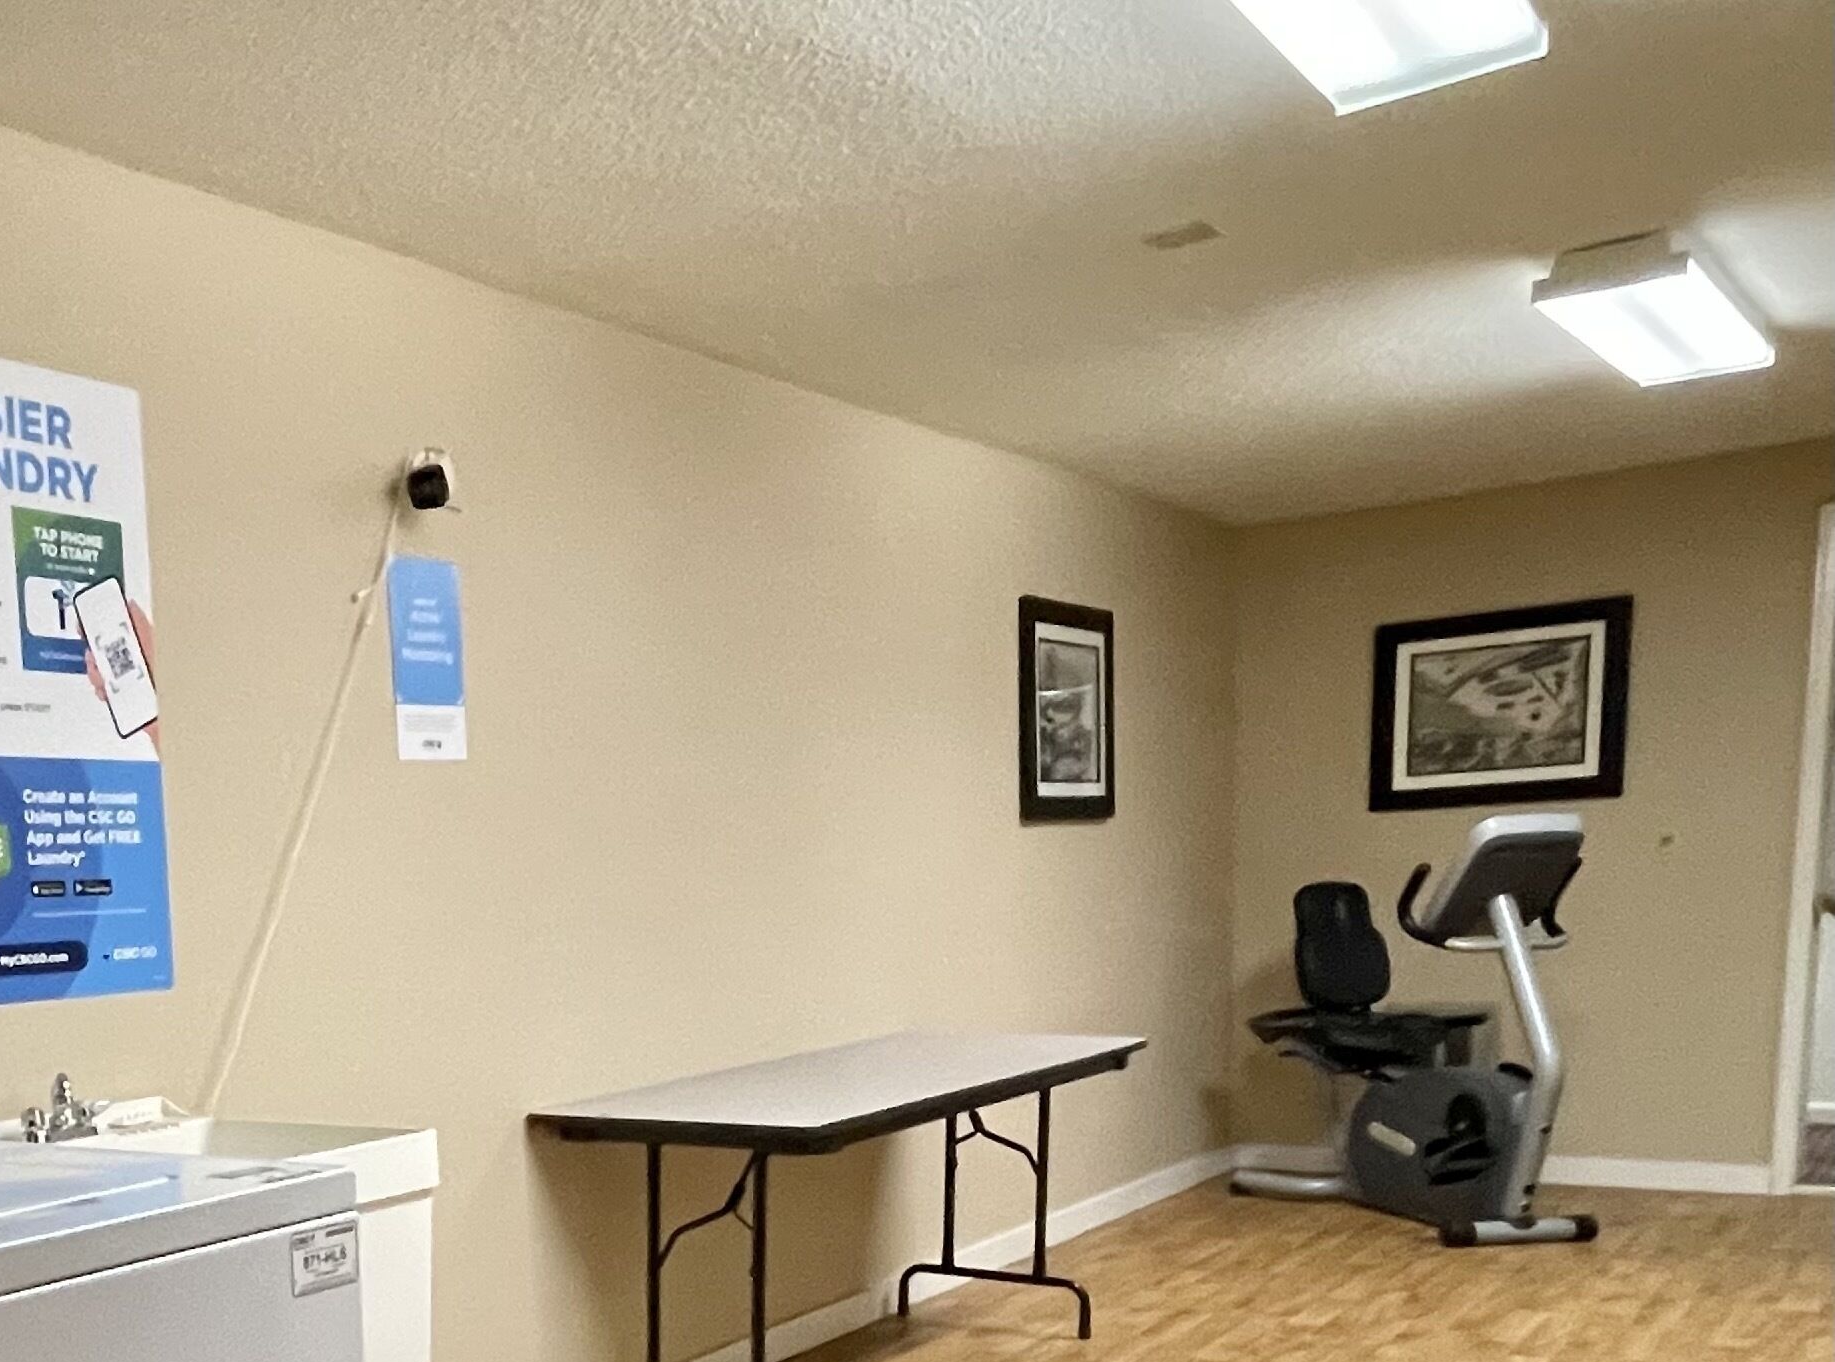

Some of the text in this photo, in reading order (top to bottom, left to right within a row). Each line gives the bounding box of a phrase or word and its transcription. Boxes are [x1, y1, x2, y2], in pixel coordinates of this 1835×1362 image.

[34, 526, 103, 549] TAP PHONE
[39, 543, 99, 563] TO START
[23, 788, 65, 804] Create
[69, 793, 84, 804] an
[24, 810, 135, 827] Using the CSC GO
[27, 830, 54, 847] App
[56, 830, 81, 844] and
[83, 830, 105, 844] Get
